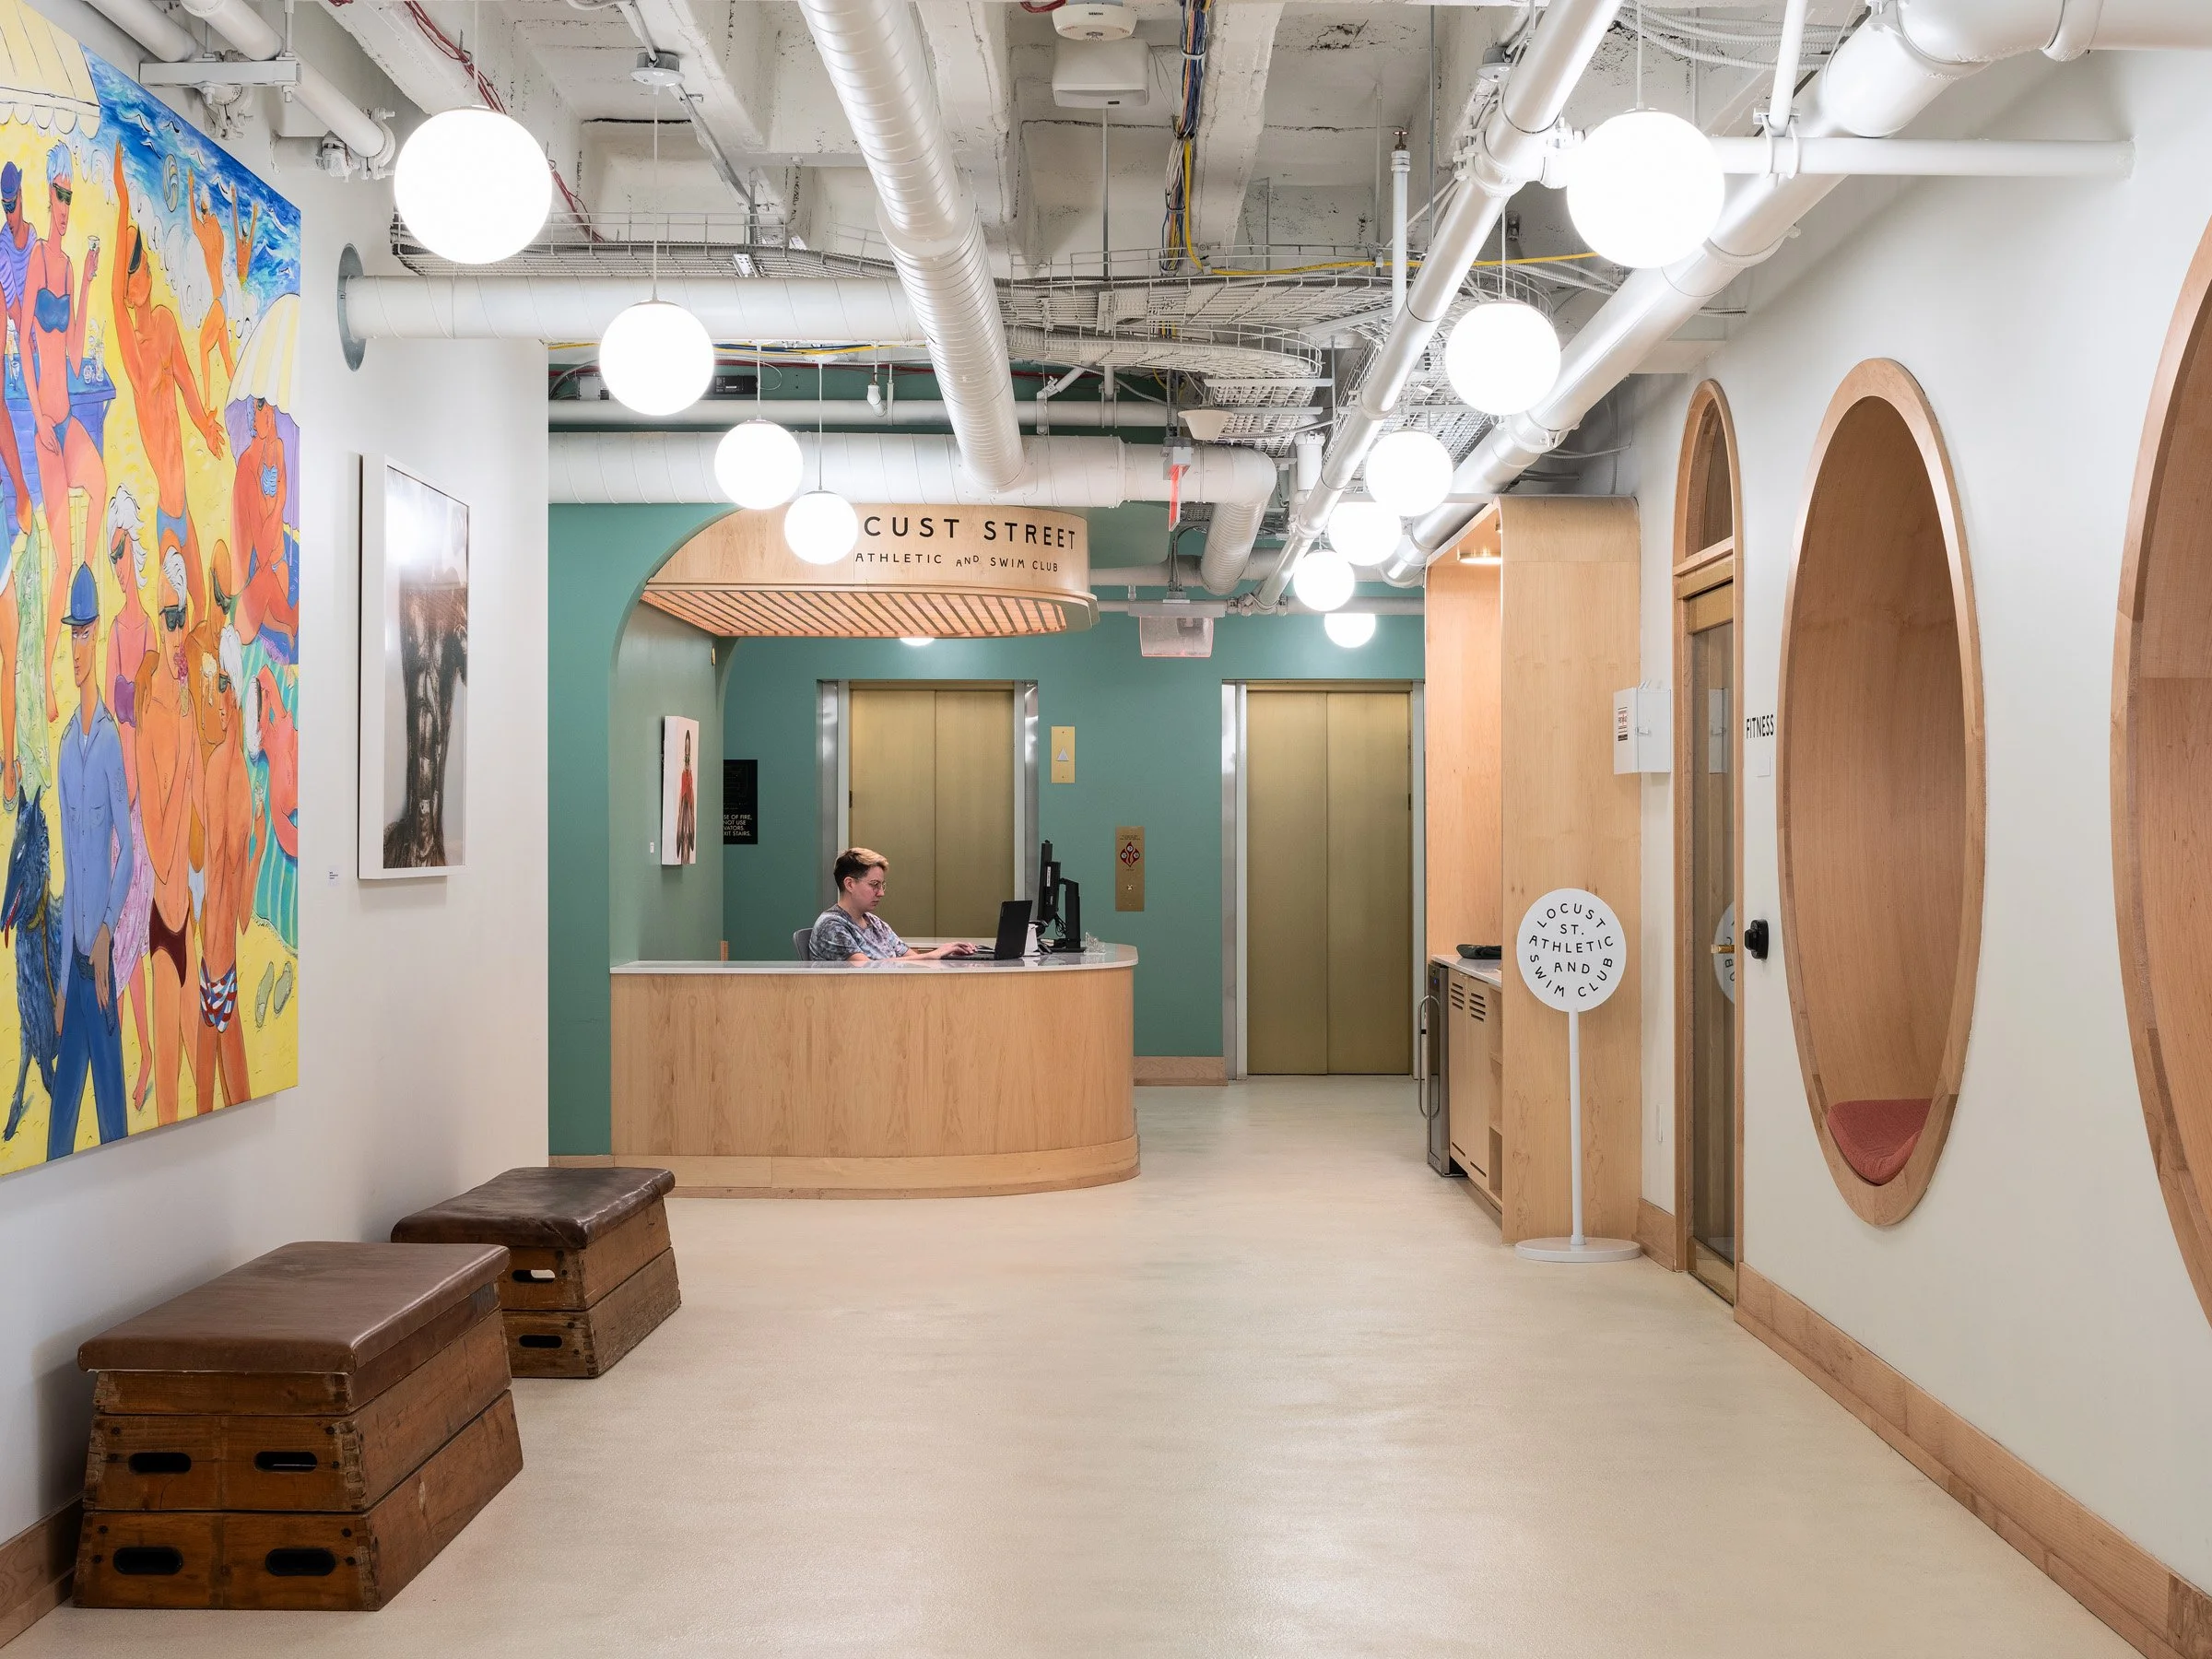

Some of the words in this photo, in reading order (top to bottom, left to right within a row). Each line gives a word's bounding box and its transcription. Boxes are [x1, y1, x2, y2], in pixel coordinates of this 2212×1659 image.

[864, 516, 959, 538] CUST
[983, 520, 1076, 549] STREET
[855, 553, 942, 564] ATHLETIC
[956, 555, 979, 567] AND
[990, 557, 1025, 569] SWIM
[1032, 560, 1058, 572] CLUB
[1746, 713, 1774, 739] FITNESS
[1537, 903, 1606, 928] LOCUST
[1560, 924, 1584, 935] ST.
[1528, 935, 1613, 953] ATHLETIC
[1530, 954, 1565, 997] SWIM
[1578, 958, 1613, 997] CLUB
[1554, 962, 1590, 974] AND
